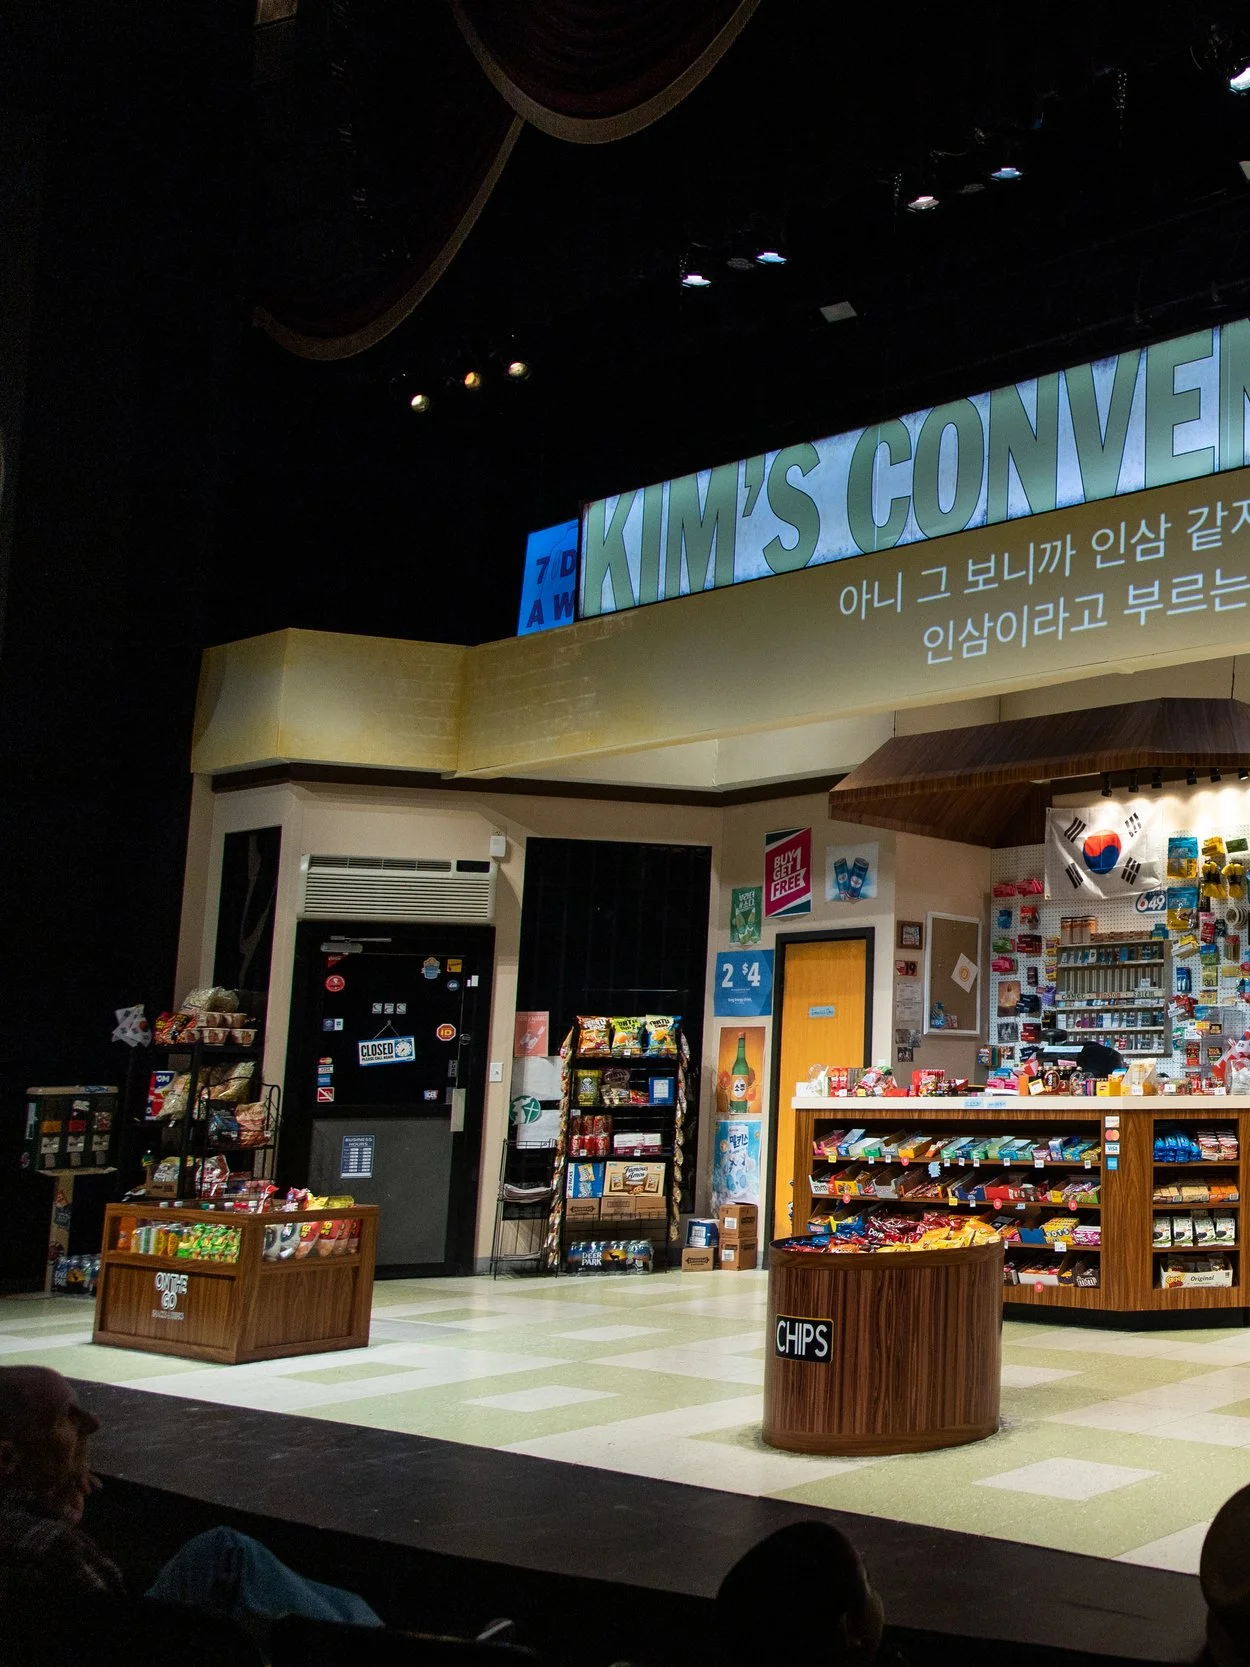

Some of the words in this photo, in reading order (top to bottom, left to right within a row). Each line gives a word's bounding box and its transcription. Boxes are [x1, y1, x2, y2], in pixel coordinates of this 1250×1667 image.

[581, 440, 820, 617] KIM'S
[839, 572, 903, 621] 아니
[916, 567, 951, 604] 그
[962, 534, 1076, 594] 보니까
[1091, 513, 1172, 569] 인삼
[922, 592, 1109, 665] 인삼이라고
[774, 849, 795, 869] BUY
[773, 861, 793, 881] GET
[772, 873, 802, 899] FREE
[722, 963, 733, 988] 2
[742, 962, 761, 988] $4
[440, 1028, 451, 1038] ID
[361, 1042, 394, 1057] CLOSED
[735, 1084, 745, 1092] 소주
[729, 1134, 748, 1149] 밀키스
[624, 1166, 648, 1174] Famous
[627, 1171, 645, 1179] Amos
[1045, 1229, 1070, 1239] DOTS
[581, 1258, 602, 1266] PARK
[170, 1273, 188, 1294] THE
[1190, 1274, 1215, 1282] Original
[161, 1290, 177, 1311] GO
[776, 1319, 829, 1358] CHIPS
